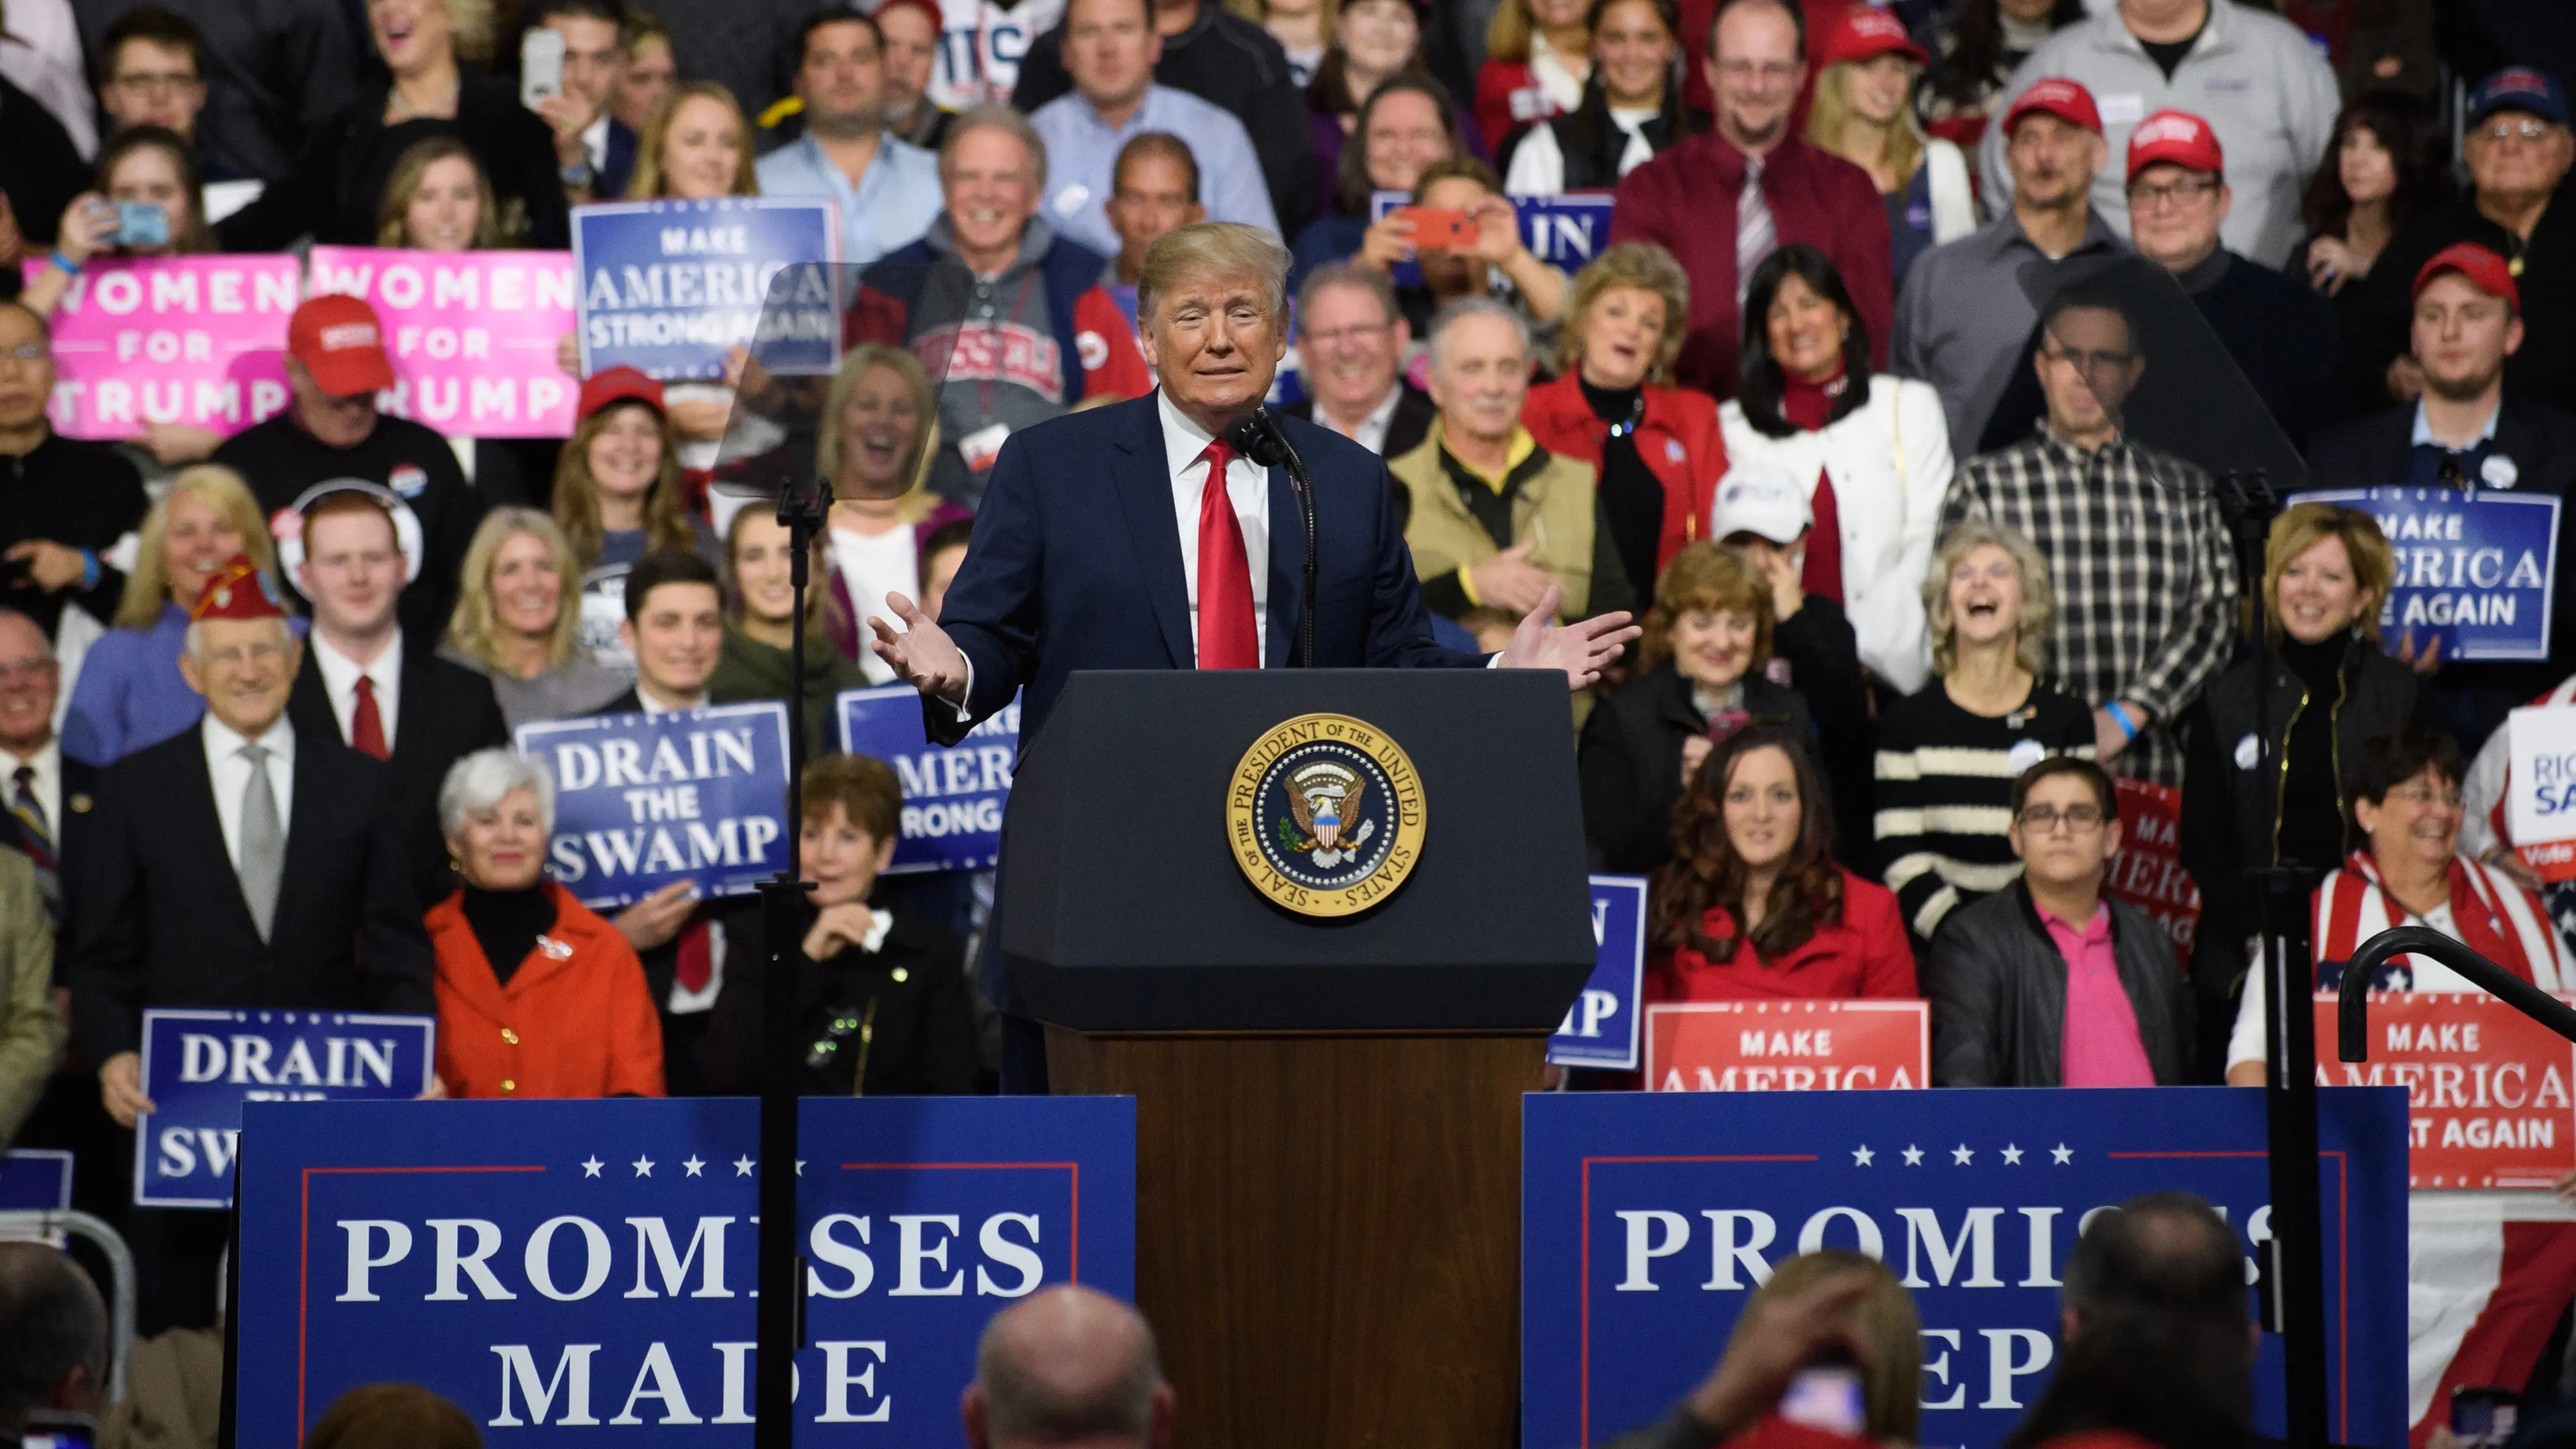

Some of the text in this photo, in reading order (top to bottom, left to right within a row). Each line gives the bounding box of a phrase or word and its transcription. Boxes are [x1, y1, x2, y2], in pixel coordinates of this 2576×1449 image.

[660, 226, 748, 254] MAKE
[315, 264, 576, 311] WOMEN
[588, 261, 830, 309] AMERICA
[116, 329, 212, 363] FOR
[396, 326, 490, 360] FOR
[589, 311, 723, 349] STRONG
[52, 378, 287, 423] TRUMP
[374, 376, 564, 421] RUMP
[2402, 593, 2516, 627] AGAIN
[555, 726, 755, 792] DRAIN
[623, 784, 702, 824] THE
[900, 798, 1002, 839] RONG
[1234, 721, 1419, 906] SEAL OF THE PRESIDENT OF THE UNITED STATES
[550, 814, 780, 883] SWAMP
[2136, 813, 2176, 849] MA
[2522, 843, 2575, 867] Vote
[1739, 1028, 1833, 1057] MAKE
[2386, 1022, 2481, 1052] MAKE
[178, 1033, 398, 1088] DRAIN
[2442, 1118, 2555, 1148] AGAIN
[1614, 1205, 2273, 1291] PROMI
[1918, 1329, 2054, 1409] EP
